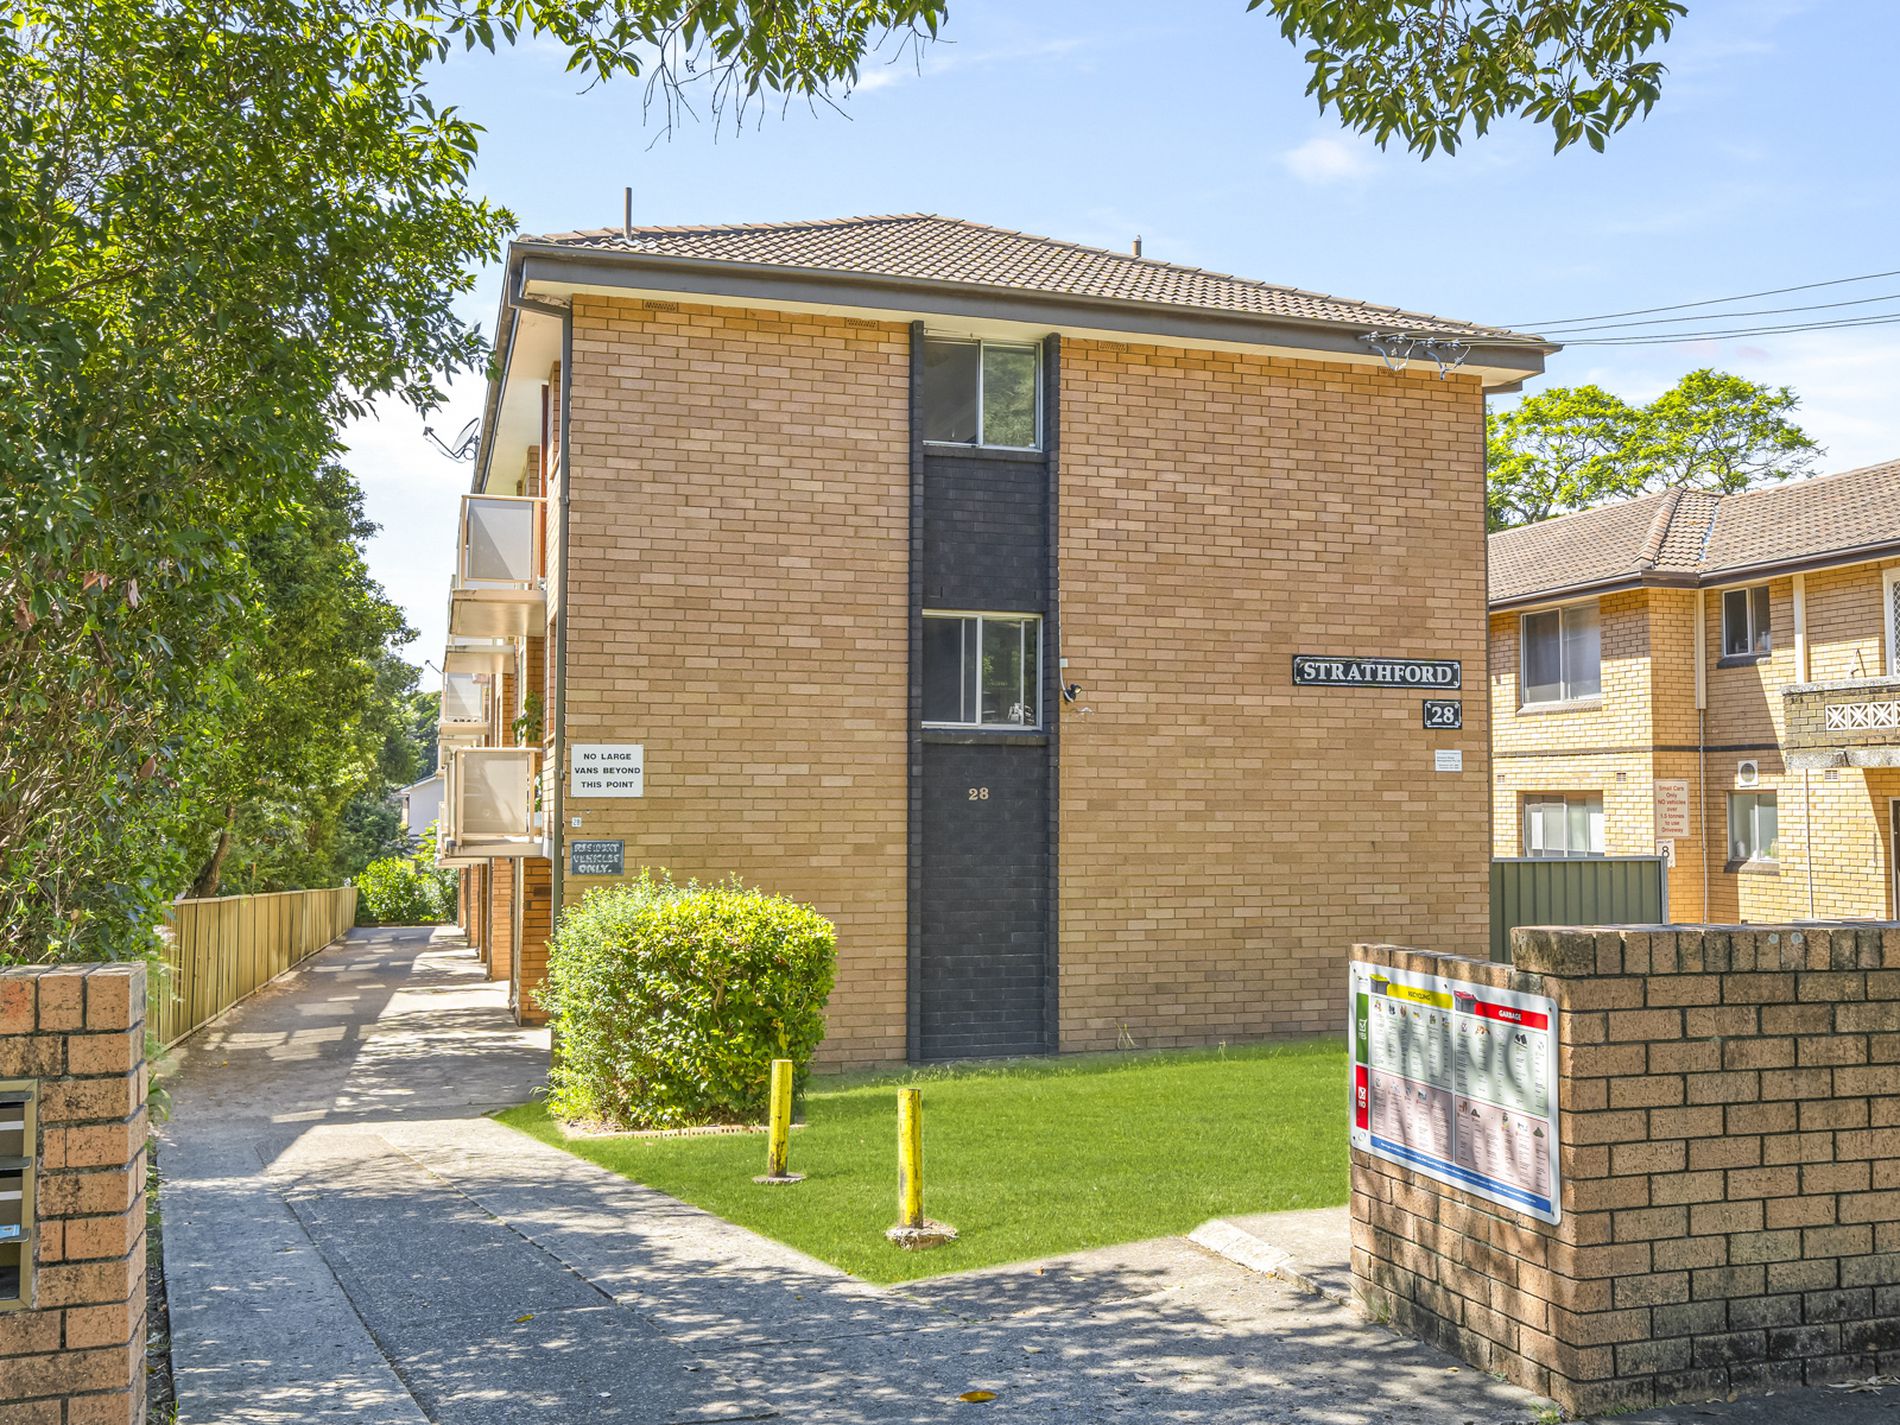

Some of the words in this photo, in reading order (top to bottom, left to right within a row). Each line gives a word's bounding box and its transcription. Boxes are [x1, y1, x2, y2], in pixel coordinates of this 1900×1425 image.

[1304, 662, 1453, 683] STRATHFORD
[1431, 706, 1455, 724] 28
[968, 787, 989, 801] 28
[1499, 1009, 1522, 1021] GARBAGE
